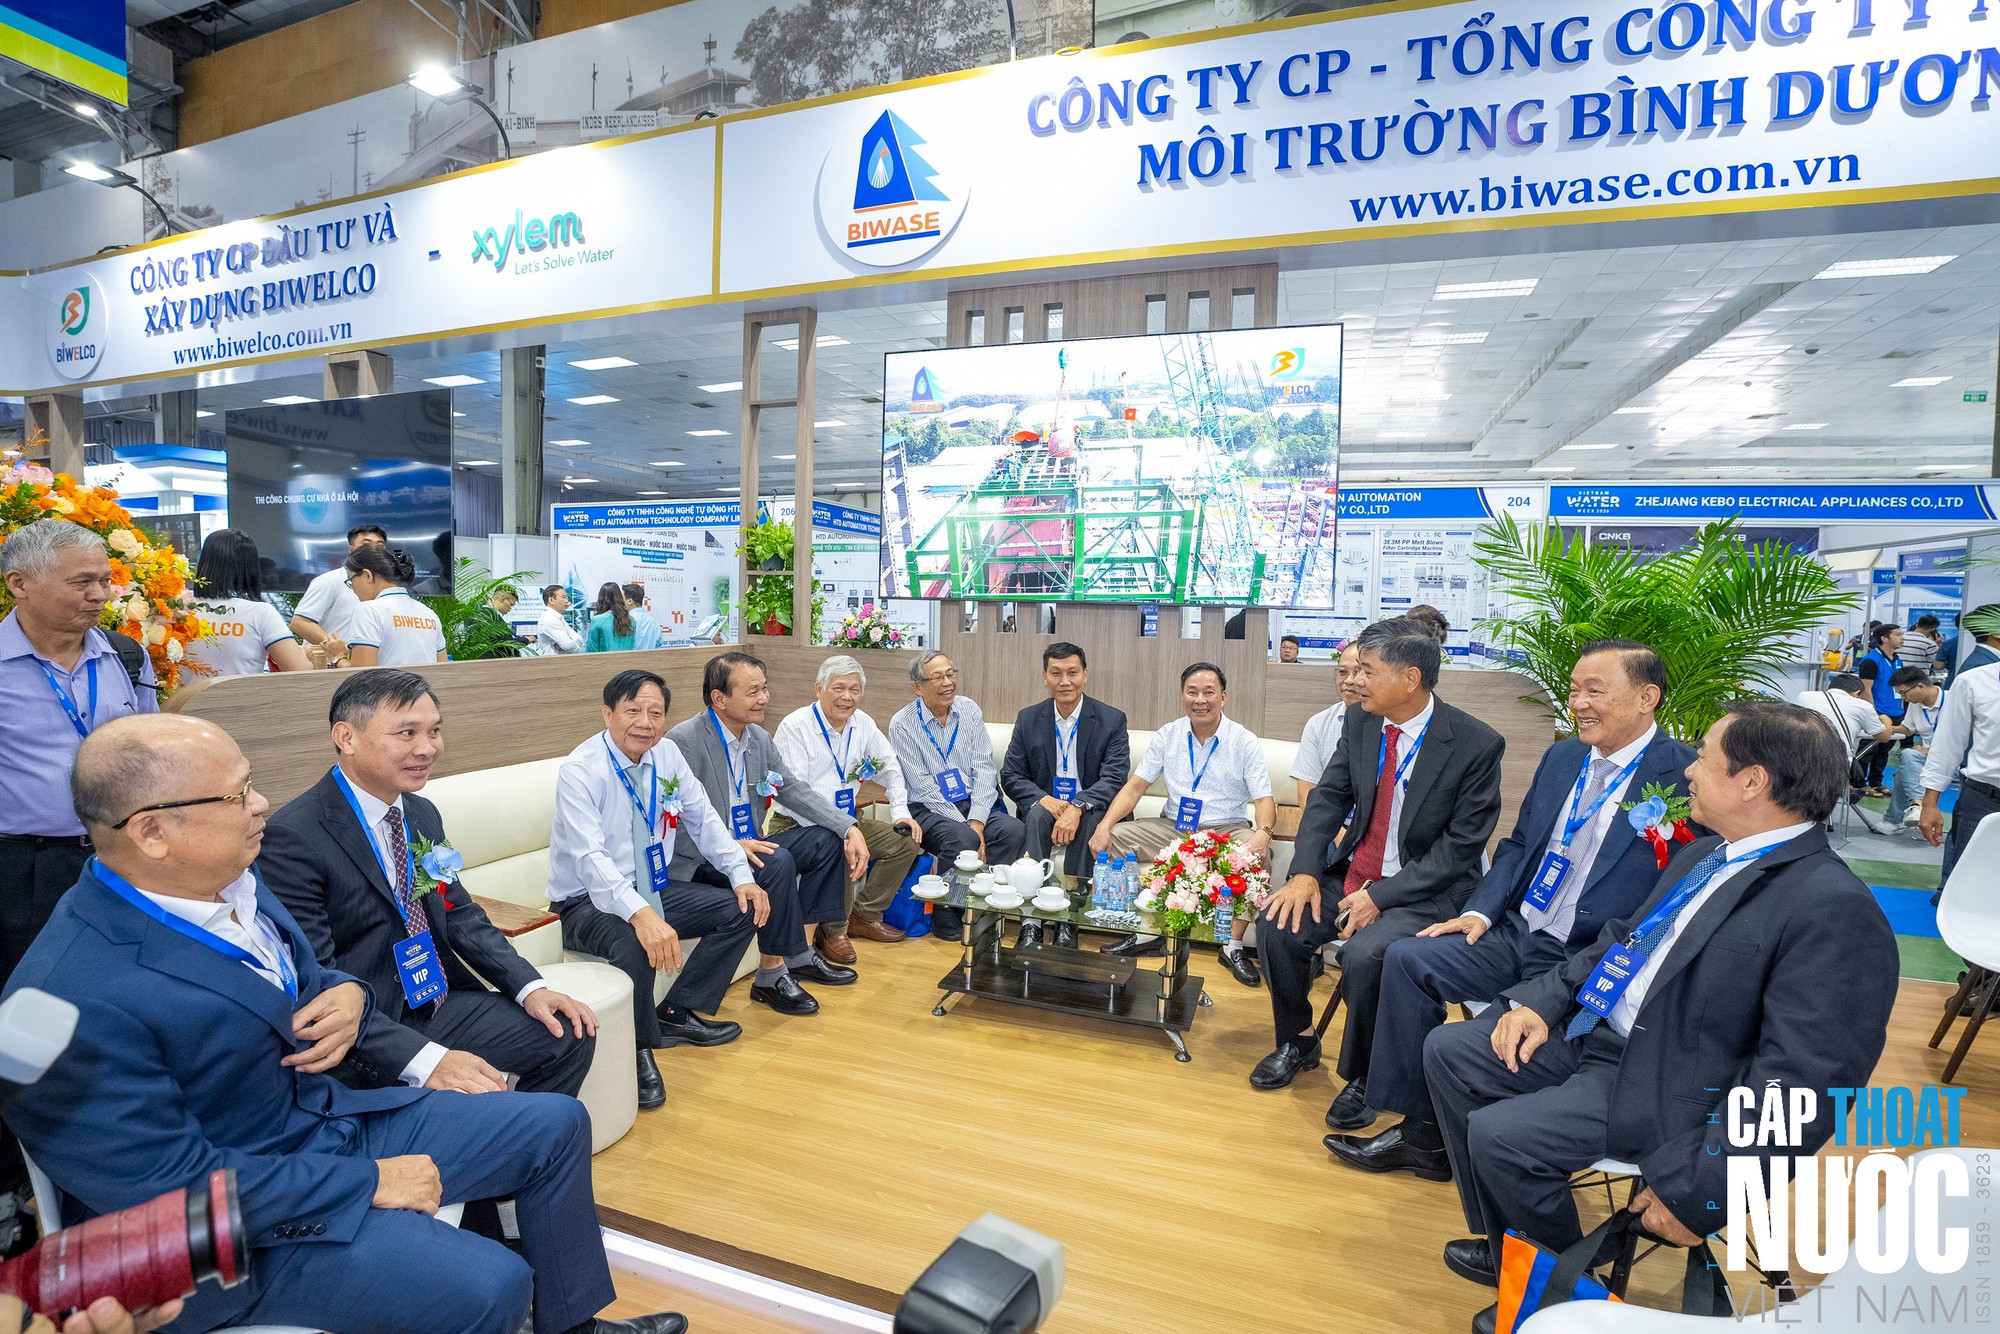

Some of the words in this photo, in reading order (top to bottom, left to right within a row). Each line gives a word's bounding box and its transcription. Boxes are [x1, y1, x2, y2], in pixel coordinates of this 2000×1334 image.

[1027, 75, 1171, 133] CÔNG
[1187, 60, 1263, 110] TY
[1278, 50, 1351, 98] CP
[1407, 12, 1593, 82] TỔNG
[582, 116, 602, 130] INDES
[1137, 125, 1248, 186] MÔI
[1265, 98, 1548, 172] TRƯỜNG
[1568, 75, 1749, 142] BÌNH
[1349, 153, 1862, 222] www.biwase.com.vn
[848, 211, 940, 241] BIWASE
[471, 207, 583, 271] xylem
[130, 257, 187, 294] CÔNG
[192, 248, 221, 280] TY
[226, 243, 255, 272] CP
[262, 224, 310, 266] ĐẦU
[317, 218, 356, 252] TƯ
[363, 202, 397, 243] VÀ
[515, 259, 540, 275] Let's
[543, 255, 575, 271] Solve
[577, 248, 615, 264] Water
[144, 296, 184, 333] XÂY
[190, 286, 254, 329] DỰNG
[262, 263, 376, 311] BIWELCO
[173, 322, 352, 365] www.biwelco.com.vn
[56, 343, 96, 363] BIWELCO
[255, 496, 265, 505] THI
[265, 494, 282, 504] CÔNG
[283, 494, 305, 504] CHUNG
[316, 492, 330, 502] NHÀ
[346, 490, 359, 503] HỘI
[1347, 492, 1422, 502] AUTOMATION
[1507, 496, 1531, 507] 204
[1567, 496, 1621, 508] WATER
[1635, 496, 1698, 507] ZHEJIANG
[1701, 496, 1736, 507] KEBO
[1738, 496, 1818, 507] ELECTRICAL
[1820, 496, 1908, 508] APPLIANCES
[1910, 496, 1964, 510] CO.,LTD
[563, 514, 590, 523] WATER
[607, 507, 625, 517] CÔNG
[626, 508, 635, 516] TY
[636, 507, 654, 516] TNHH
[655, 505, 674, 515] CÔNG
[676, 505, 694, 515] NGHỆ
[706, 504, 726, 515] ĐỘNG
[781, 508, 796, 516] 206
[1349, 505, 1390, 516] CO.,LTD
[593, 518, 606, 526] HTD
[607, 517, 649, 526] AUTOMATION
[651, 516, 694, 525] TECHNOLOGY
[695, 515, 729, 524] COMPANY
[393, 614, 436, 631] BIWELCO
[1059, 793, 1070, 801] VIP
[1183, 814, 1194, 823] VIP
[411, 968, 429, 985] VIP
[1595, 976, 1614, 993] VIP
